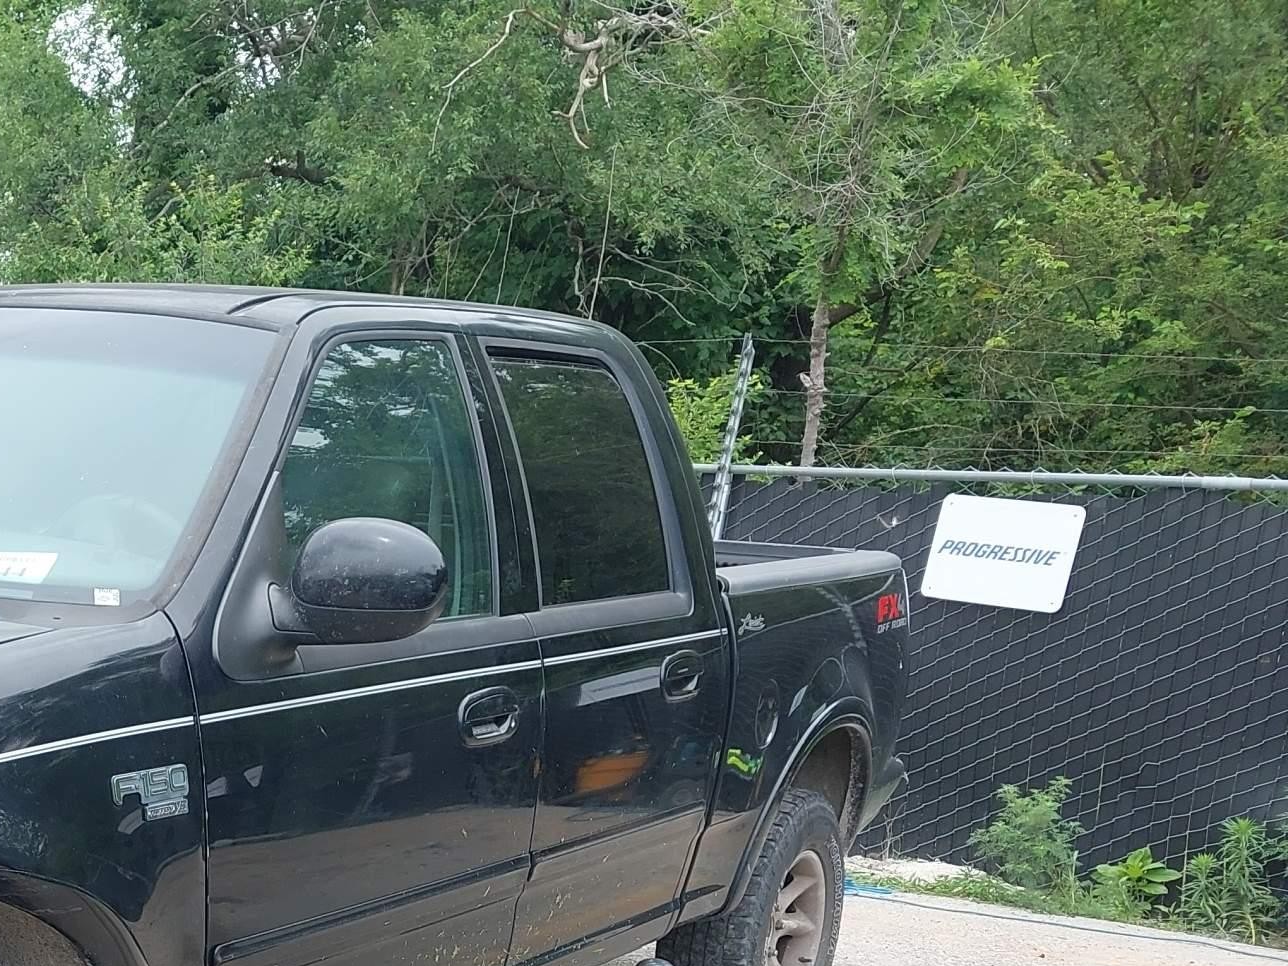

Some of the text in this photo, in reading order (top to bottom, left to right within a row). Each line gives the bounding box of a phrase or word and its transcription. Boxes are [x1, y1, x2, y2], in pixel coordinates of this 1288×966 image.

[938, 539, 1060, 566] PROGRESSIVE
[876, 593, 905, 625] FX4
[876, 617, 908, 634] OFF ROAD
[824, 835, 843, 956] YOKOHAMA
